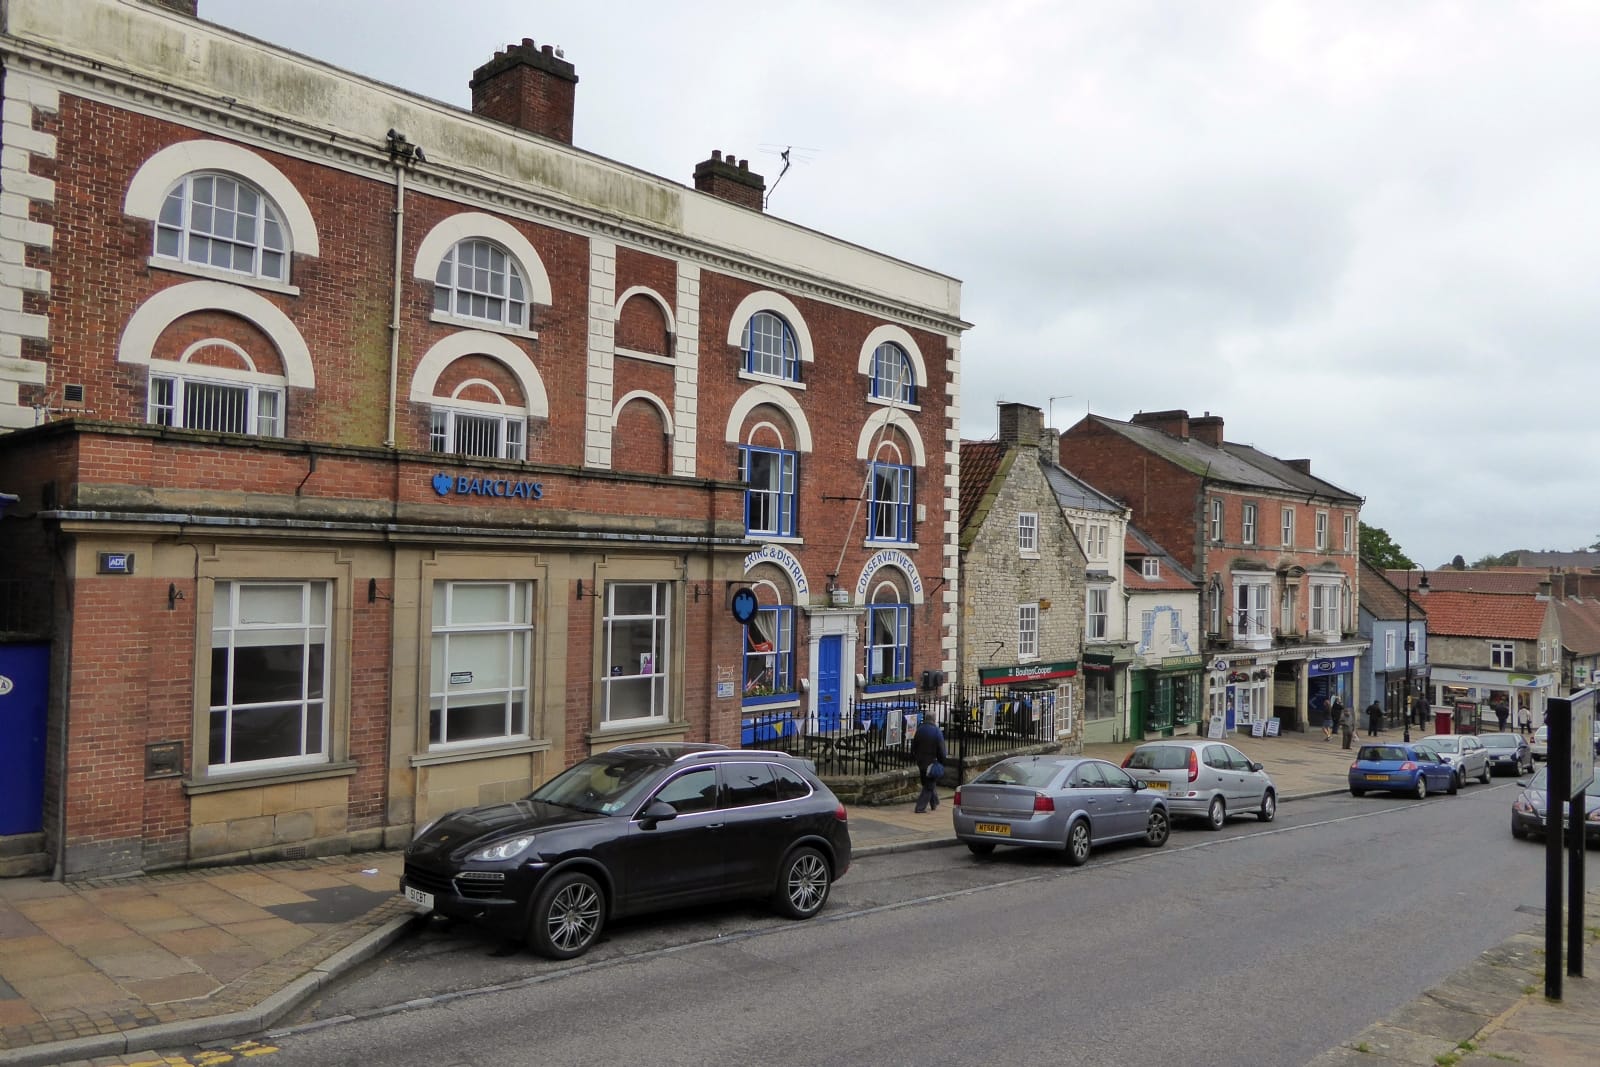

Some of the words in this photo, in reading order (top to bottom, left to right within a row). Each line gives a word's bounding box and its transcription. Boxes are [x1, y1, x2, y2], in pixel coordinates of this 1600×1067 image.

[456, 476, 544, 500] BARCLAYS
[110, 558, 125, 566] ADT
[776, 549, 808, 595] DISTRICT
